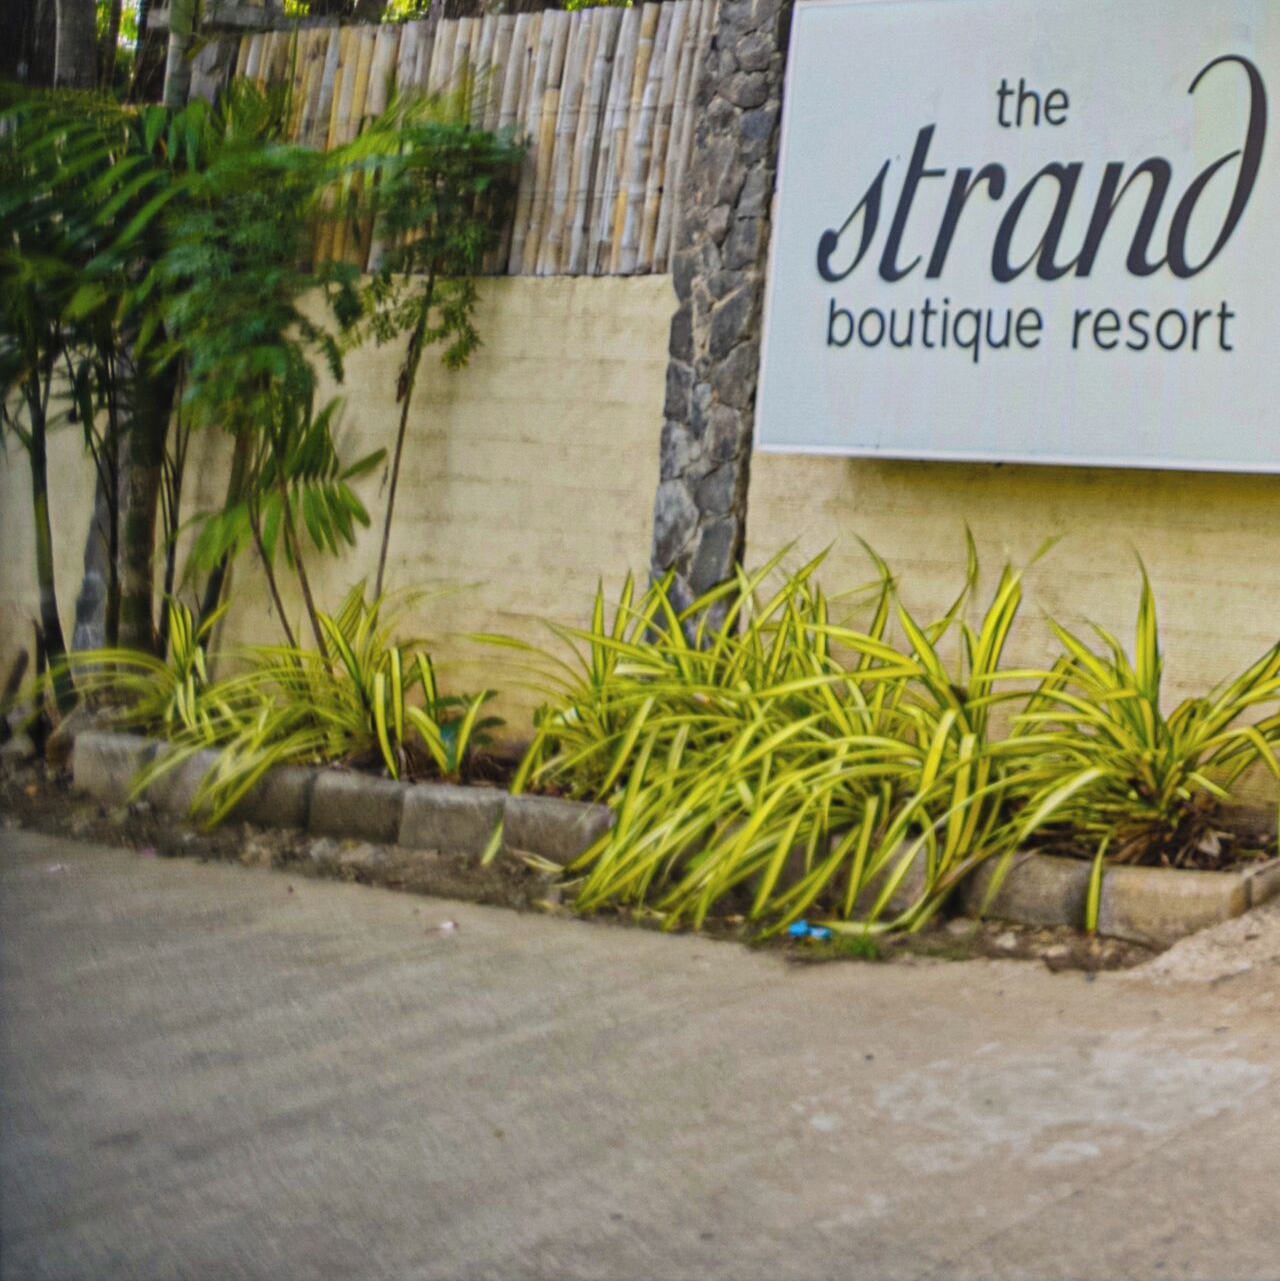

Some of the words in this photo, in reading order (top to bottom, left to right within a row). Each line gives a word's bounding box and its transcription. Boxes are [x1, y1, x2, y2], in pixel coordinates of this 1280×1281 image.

[997, 78, 1070, 128] the
[817, 54, 1268, 283] strand
[827, 298, 1043, 363] boutique
[1072, 301, 1235, 351] resort
